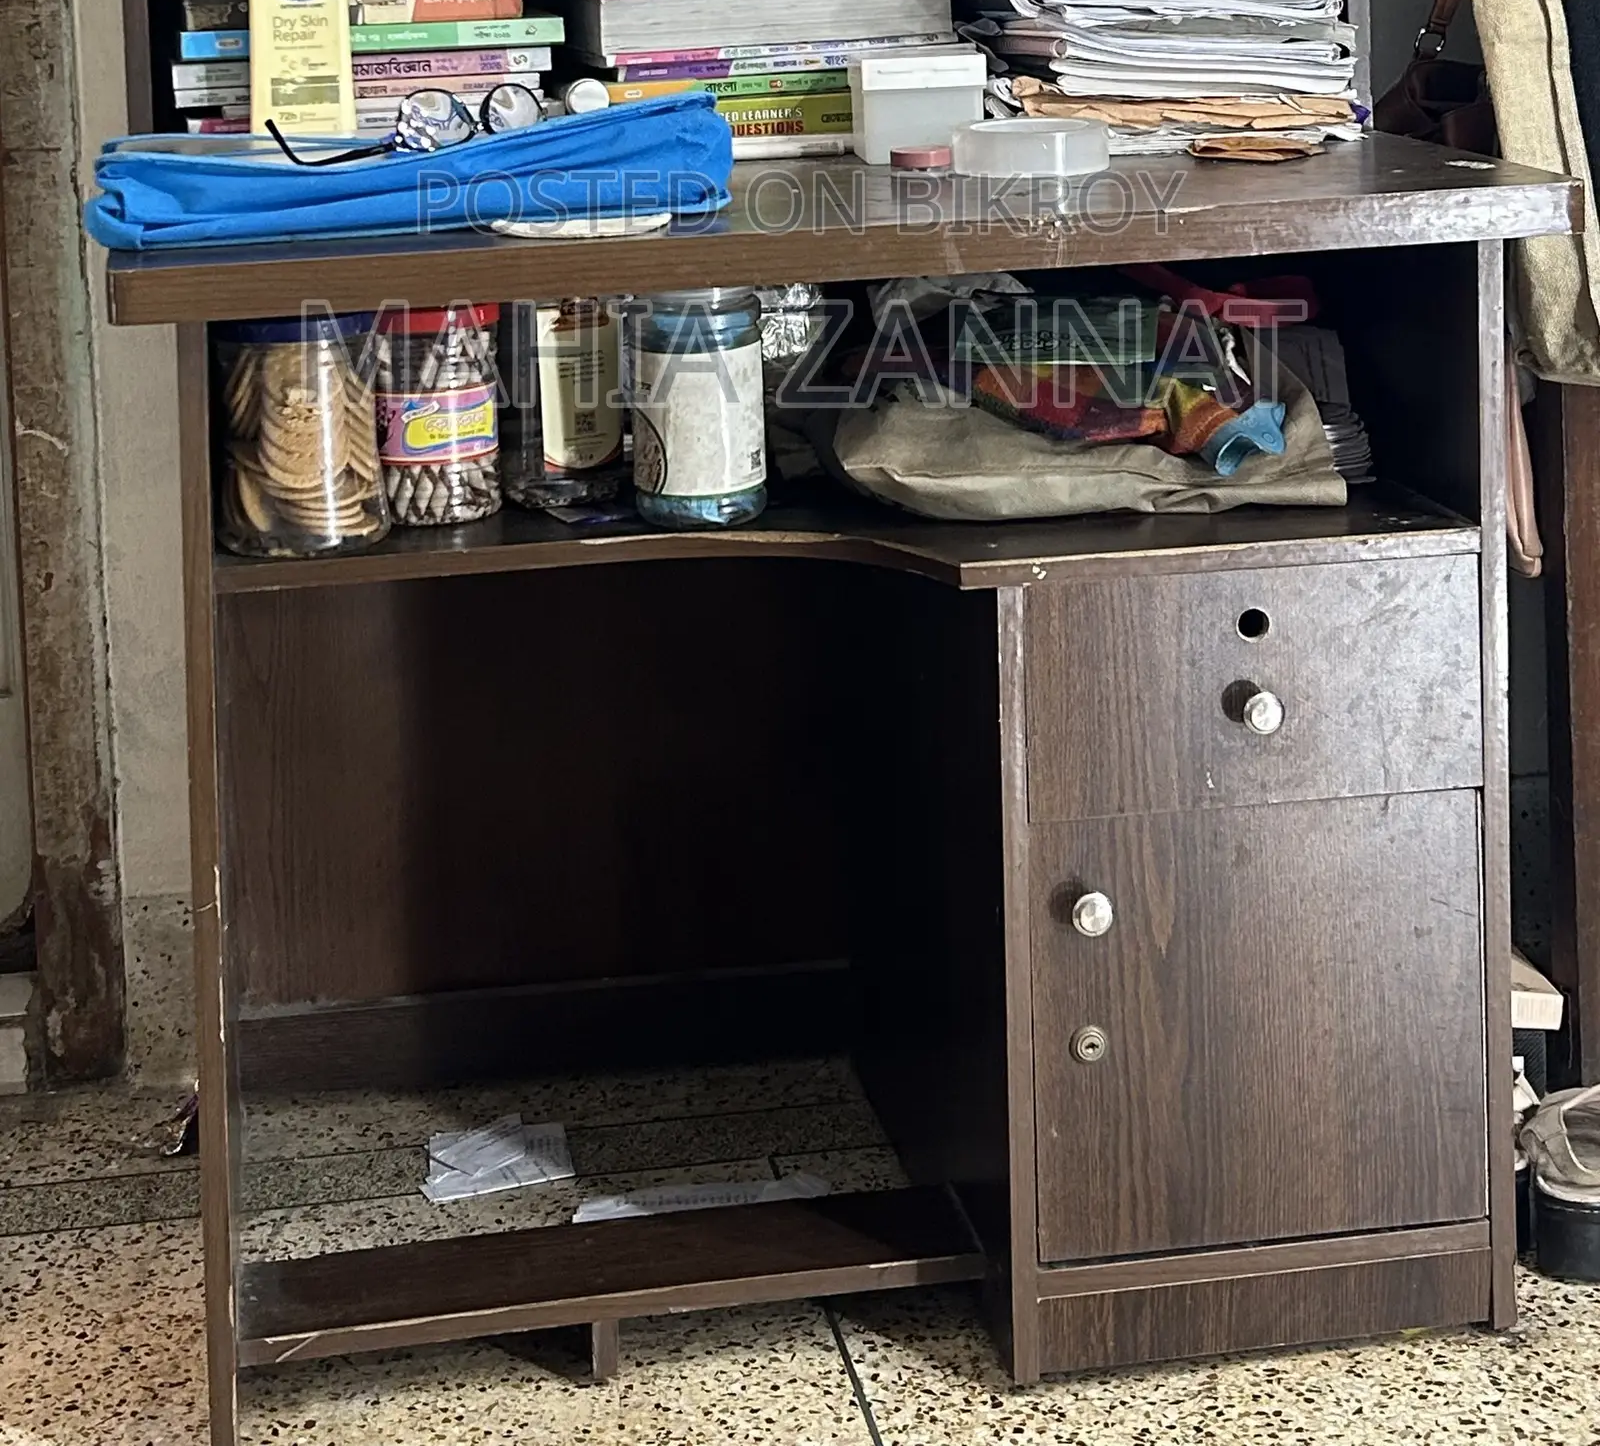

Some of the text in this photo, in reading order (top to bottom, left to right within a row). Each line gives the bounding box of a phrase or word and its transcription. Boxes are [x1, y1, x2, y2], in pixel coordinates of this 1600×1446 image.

[272, 14, 328, 31] Dry Skin
[273, 29, 316, 43] Repair
[352, 57, 431, 76] সমাজবিজ্ঞান
[704, 81, 737, 94] বাংলা
[742, 106, 802, 121] LEARNER'S
